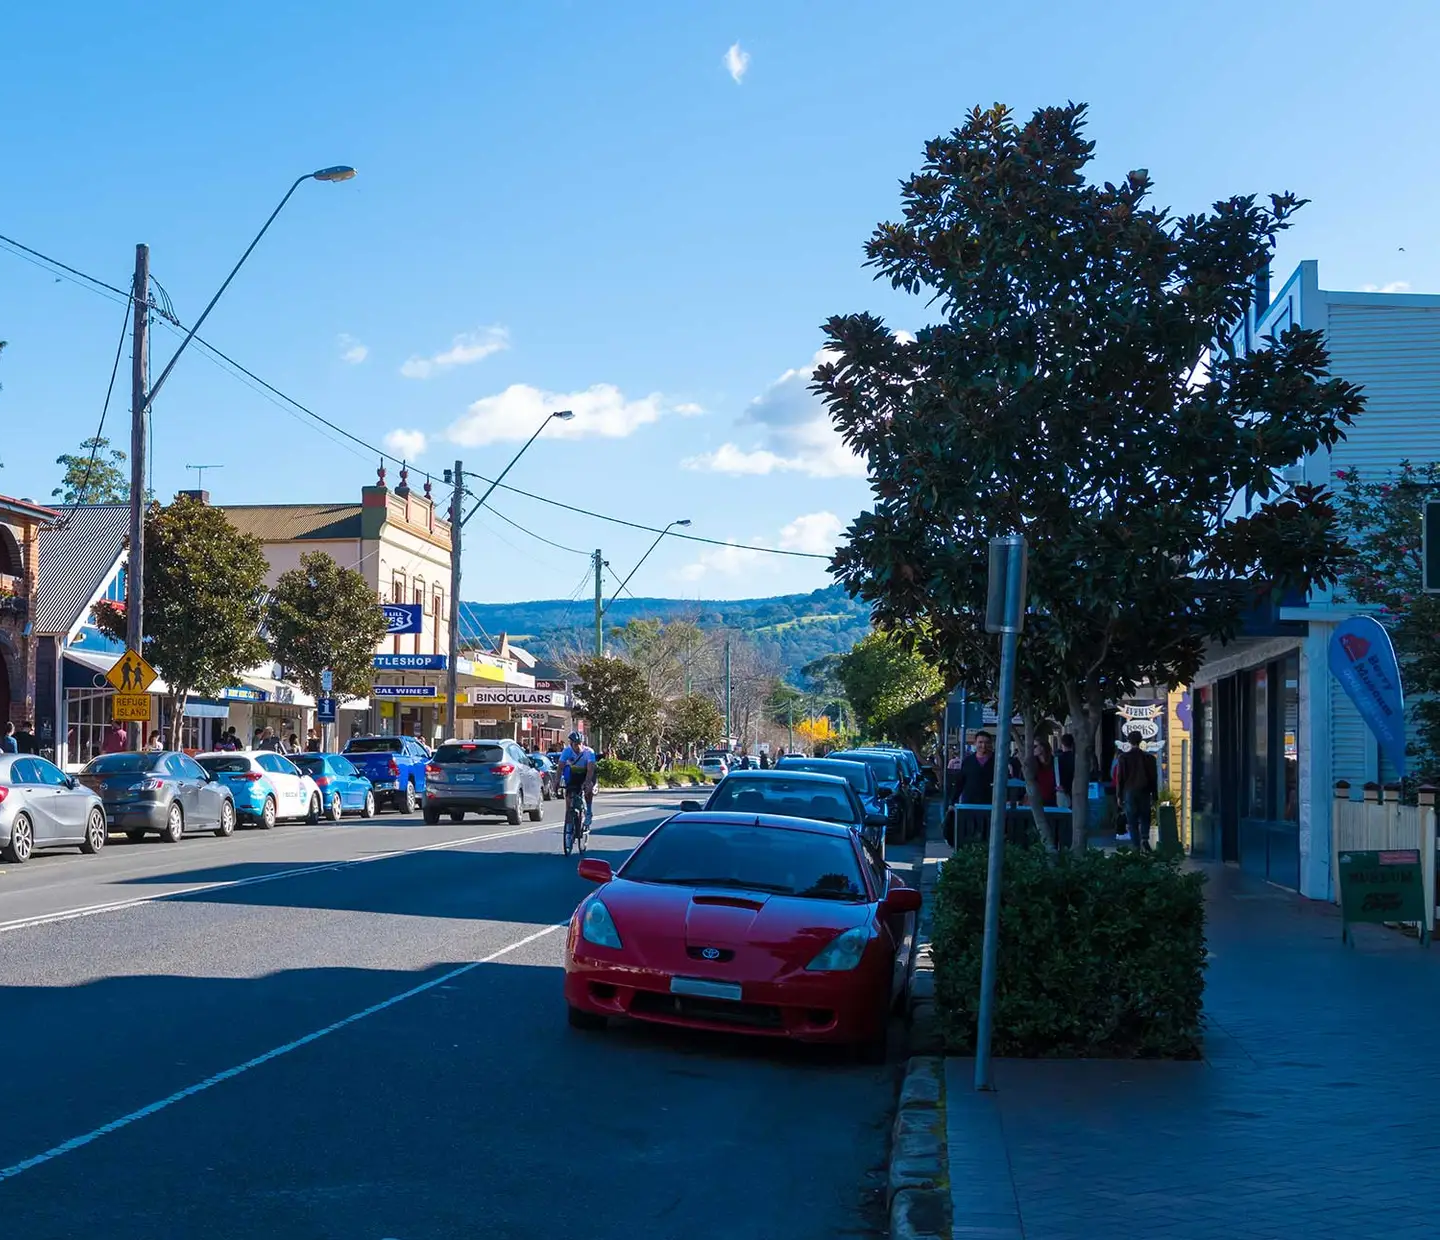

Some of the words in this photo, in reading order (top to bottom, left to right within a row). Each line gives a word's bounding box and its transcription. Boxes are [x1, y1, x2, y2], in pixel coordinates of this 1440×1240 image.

[116, 698, 147, 706] REFUGE
[476, 693, 551, 703] BINOCULARS
[116, 708, 147, 716] ISLAND
